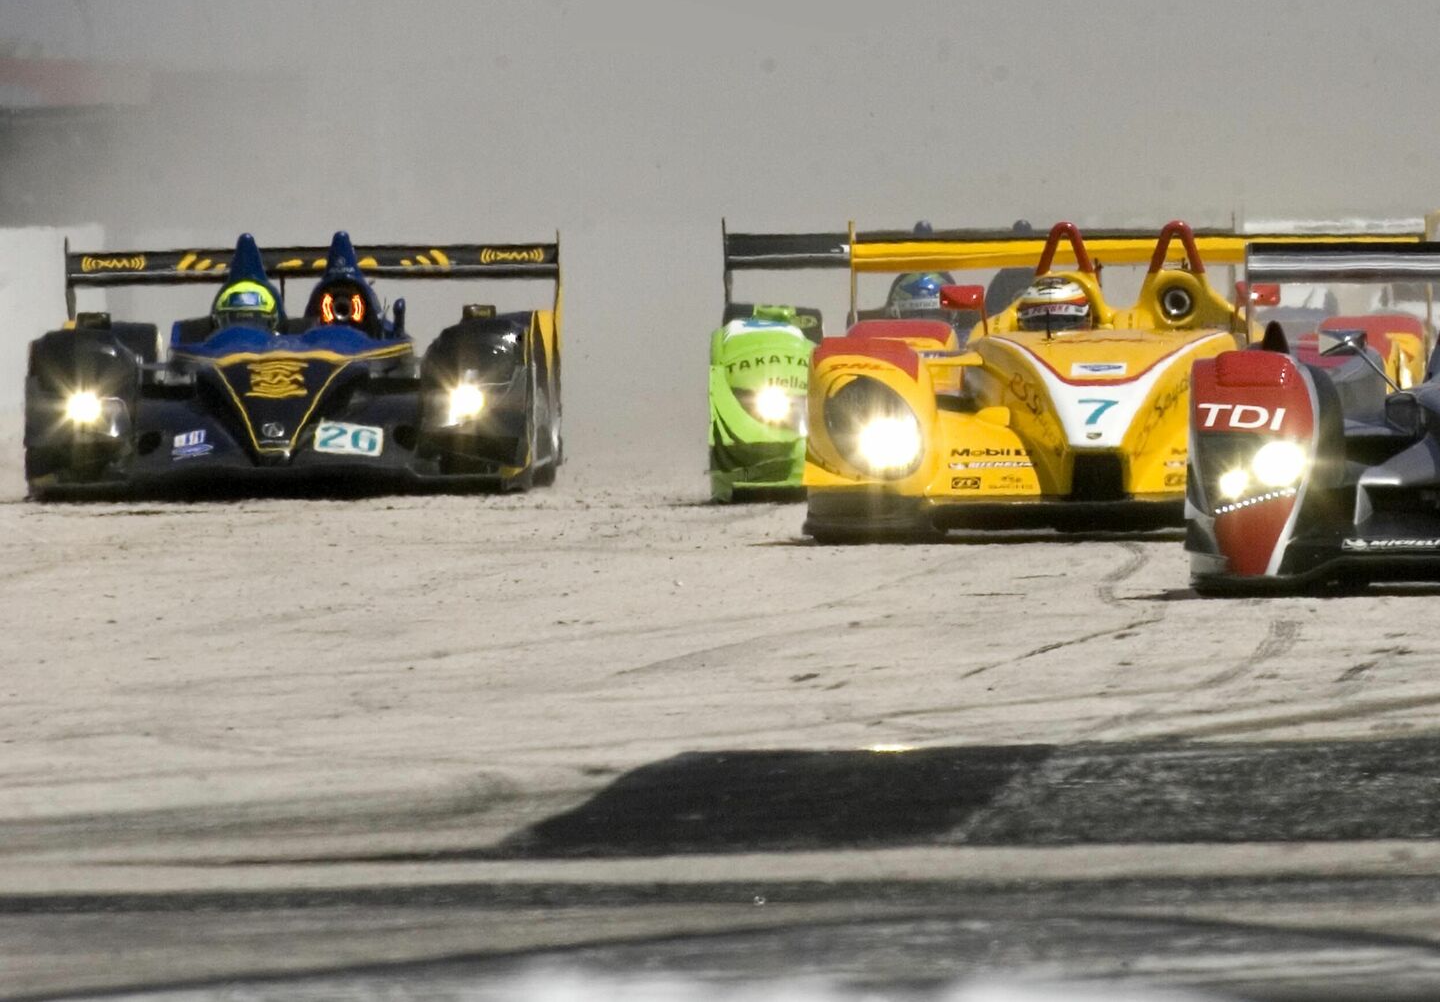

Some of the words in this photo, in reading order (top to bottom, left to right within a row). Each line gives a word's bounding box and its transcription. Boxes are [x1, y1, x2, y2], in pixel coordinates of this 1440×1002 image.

[724, 354, 809, 375] TAKATA
[1077, 398, 1120, 426] 7
[1197, 402, 1287, 431] TDI
[320, 425, 377, 453] 26
[949, 448, 1011, 457] Mobil
